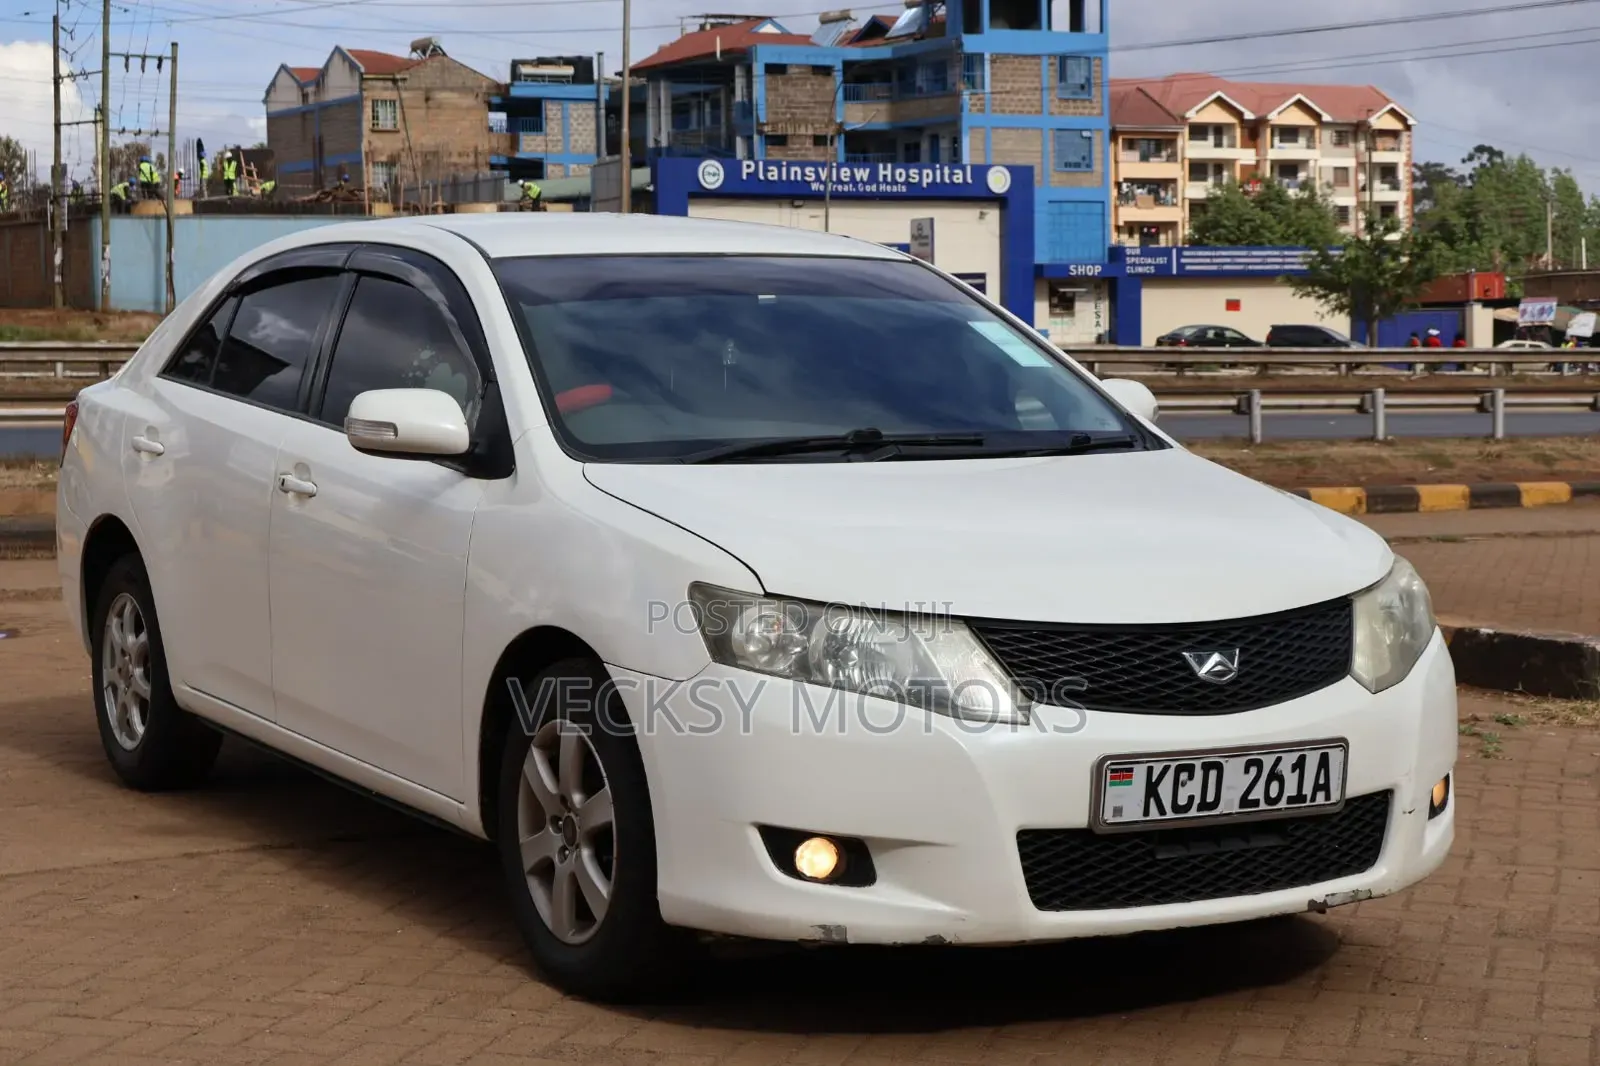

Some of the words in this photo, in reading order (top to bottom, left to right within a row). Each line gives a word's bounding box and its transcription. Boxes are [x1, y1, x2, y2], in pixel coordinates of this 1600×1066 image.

[741, 160, 870, 182] Plainsview
[878, 162, 973, 188] Hospital
[811, 182, 825, 192] We
[879, 183, 907, 193] Heals
[1125, 247, 1141, 256] OUR
[1125, 256, 1168, 265] SPECIALIST
[1068, 264, 1102, 276] SHOP
[1125, 265, 1155, 274] CLINICS
[1142, 760, 1224, 817] KCD
[1238, 751, 1332, 810] 261A
